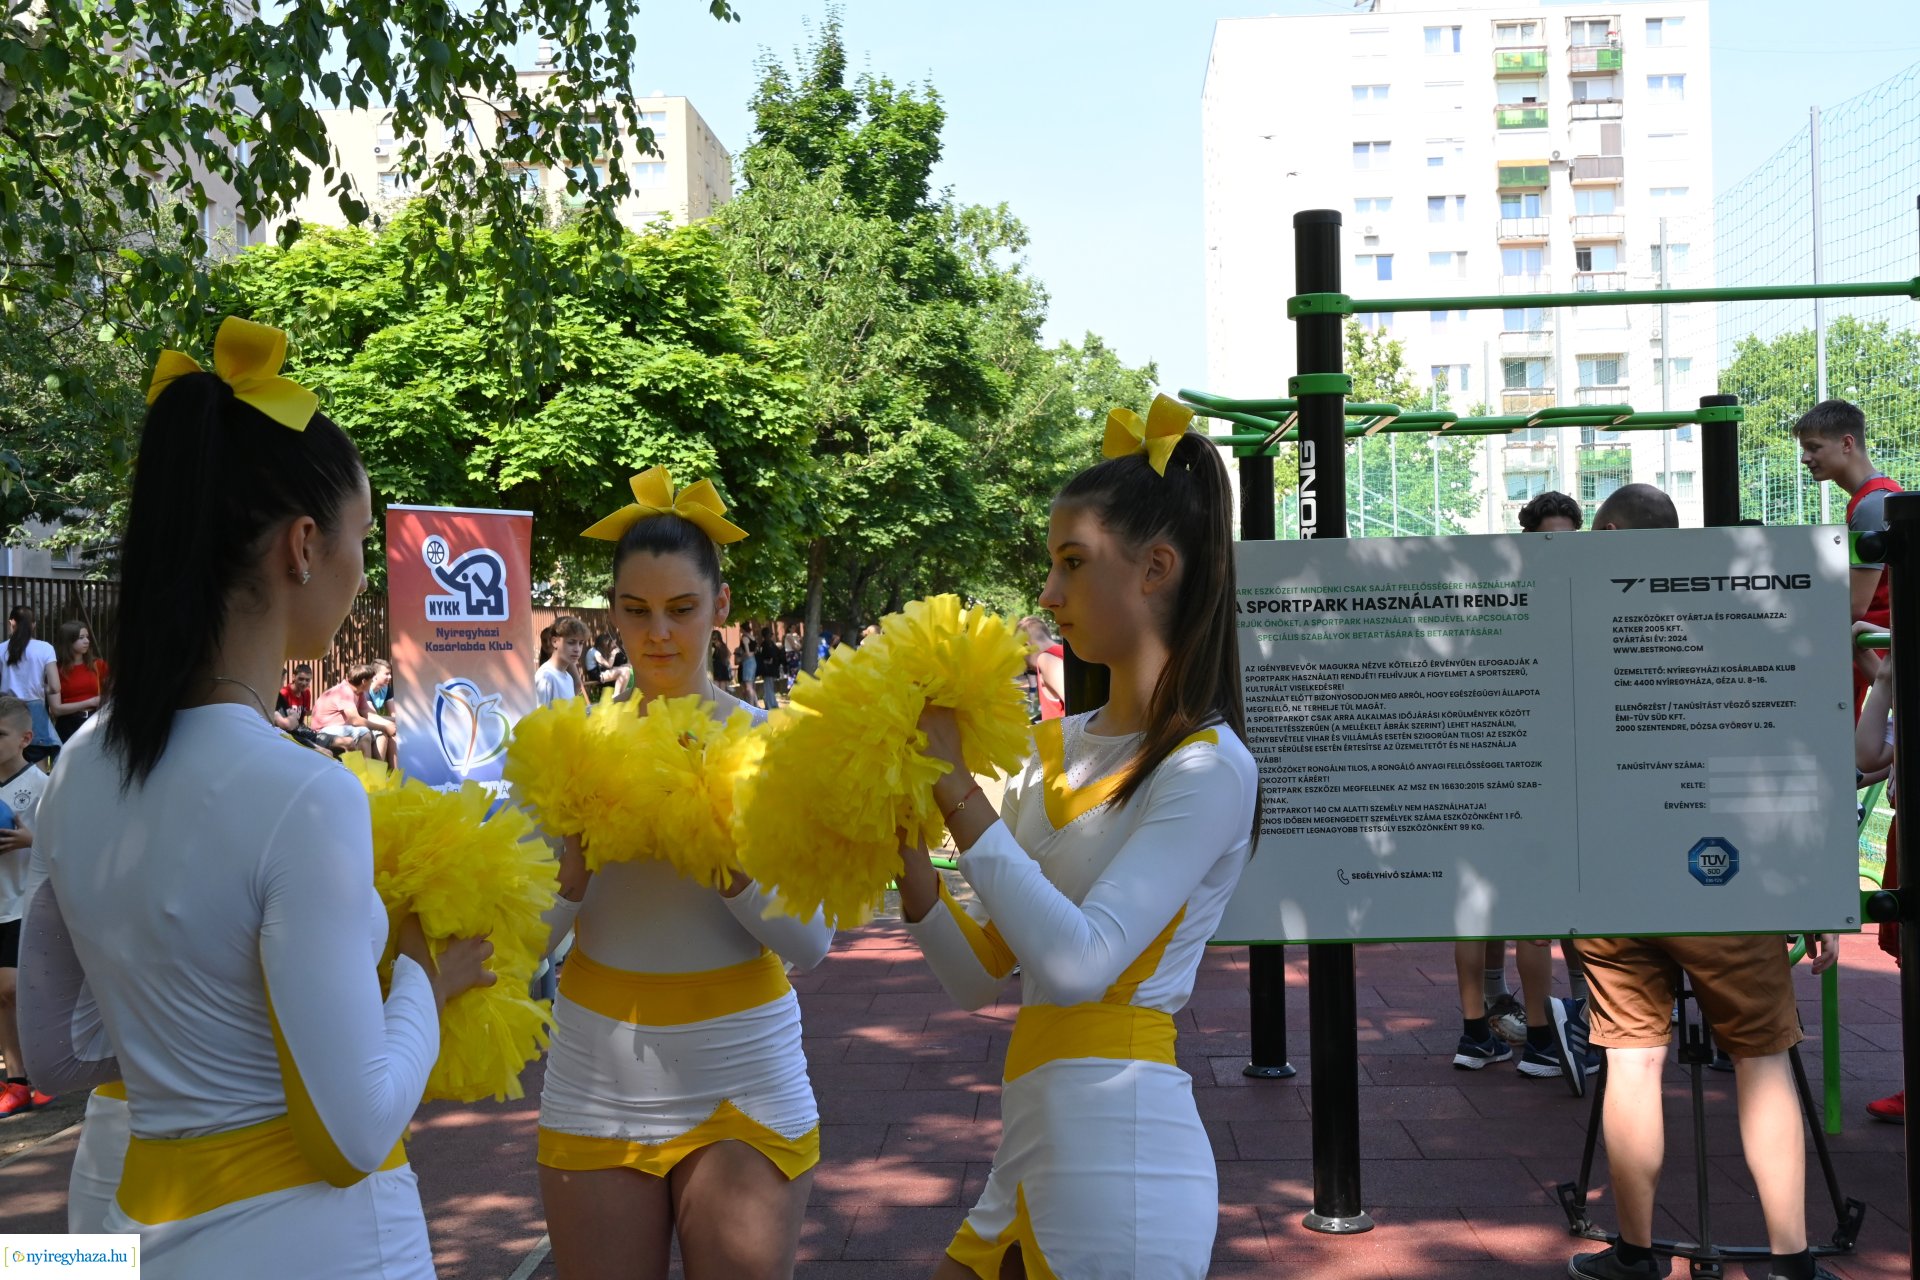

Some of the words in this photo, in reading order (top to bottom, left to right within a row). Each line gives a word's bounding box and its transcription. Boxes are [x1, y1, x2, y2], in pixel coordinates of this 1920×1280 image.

[1650, 573, 1811, 594] BESTRONG
[429, 601, 460, 615] NYKK
[1246, 598, 1347, 614] SPORTPARK
[1352, 591, 1458, 611] HASZNÁLATI
[1463, 593, 1528, 608] RENDJE
[1612, 615, 1622, 623] AZ
[1624, 612, 1674, 623] ESZKÖZÖKET
[1676, 611, 1713, 622] GYÁRTJA
[1715, 611, 1724, 621] ÉS
[1725, 612, 1787, 620] FORGALMAZZA:
[1612, 625, 1643, 633] KATKER
[1644, 624, 1664, 633] 2005
[1666, 624, 1684, 632] KFT.
[1612, 633, 1652, 644] GYÁRTÁSI
[1654, 632, 1666, 643] ÉV:
[1667, 634, 1687, 642] 2024
[489, 641, 512, 651] Klub
[1613, 644, 1704, 654] WWW.BESTRONG.COM
[1319, 662, 1359, 670] MAGUKRA
[1362, 659, 1386, 669] NÉZVE
[1478, 656, 1529, 666] ELFOGADJÁK
[1666, 663, 1719, 674] NYÍREGYHÁZI
[1720, 662, 1774, 673] KOSÁRLABDA
[1775, 664, 1796, 672] KLUB
[1245, 674, 1290, 682] SPORTPARK
[1292, 671, 1338, 681] HASZNÁLATI
[1340, 670, 1376, 680] RENDJÉT!
[1378, 669, 1418, 679] FELHÍVJUK
[1427, 670, 1467, 678] FIGYELMET
[1633, 678, 1654, 686] 4400
[1715, 674, 1736, 685] GÉZA
[1737, 676, 1745, 684] U.
[1747, 676, 1768, 684] 8-16.
[1245, 683, 1287, 693] KULTURÁLT
[1289, 682, 1345, 692] VISELKEDÉSRE!
[1246, 692, 1289, 703] HASZNÁLAT
[1314, 692, 1378, 701] BIZONYOSODJON
[1380, 692, 1397, 700] MEG
[1449, 688, 1500, 698] EGÉSZÉGÜGYI
[1502, 686, 1541, 697] ÁLLAPOTA
[1304, 704, 1338, 712] TERHELJE
[1340, 701, 1353, 711] TÚL
[1355, 700, 1387, 710] MAGÁT.
[1672, 699, 1722, 710] TANÚSÍTÁST
[1751, 700, 1797, 708] SZERVEZET:
[1253, 714, 1308, 723] SPORTPARKOT
[1333, 713, 1354, 721] ARRA
[1356, 712, 1396, 720] ALKALMAS
[1441, 708, 1497, 719] KÖRÜLMÉNYEK
[1499, 708, 1531, 717] KÖZÖTT
[1615, 711, 1649, 722] ÉMI-TÜV
[1650, 711, 1667, 721] SÜD
[1668, 713, 1686, 721] KFT.
[1342, 721, 1381, 731] MELLÉKELT
[1383, 720, 1409, 730] ÁBRÁK
[1411, 721, 1445, 731] SZERINT)
[1447, 721, 1469, 729] LEHET
[1470, 718, 1516, 729] HASZNÁLNI,
[1615, 724, 1635, 732] 2000
[1637, 723, 1688, 733] SZENTENDRE,
[1690, 720, 1717, 730] DÓZSA
[1718, 719, 1752, 730] GYÖRGY
[1754, 721, 1762, 729] U.
[1763, 721, 1776, 729] 26.
[1341, 731, 1382, 742] VILLÁMLÁS
[1384, 731, 1411, 740] ESETÉN
[1413, 730, 1458, 740] SZIGORÚAN
[1460, 731, 1484, 739] TILOS!
[1498, 728, 1528, 738] ESZKÖZ
[1277, 743, 1312, 753] SÉRÜLÉSE
[1314, 742, 1342, 752] ESETÉN
[1344, 742, 1381, 752] ÉRTESÍTSE
[1471, 738, 1517, 749] HASZNÁLJA
[1259, 764, 1306, 774] ESZKÖZÖKET
[1307, 763, 1346, 773] RONGÁLNI
[1347, 764, 1369, 773] TILOS,
[1378, 761, 1415, 771] RONGÁLÓ
[1505, 760, 1543, 768] TARTOZIK
[1616, 760, 1672, 771] TANÚSÍTVÁNY
[1674, 759, 1705, 770] SZÁMA:
[1298, 773, 1330, 783] KÁRÉRT!
[1304, 783, 1340, 793] ESZKÖZEI
[1342, 784, 1394, 792] MEGFELELNEK
[1410, 783, 1426, 791] MSZ
[1441, 782, 1484, 790] 16630:2015
[1486, 780, 1514, 789] SZÁMÚ
[1516, 781, 1543, 789] SZAB-
[1680, 781, 1706, 789] KELTE:
[1313, 806, 1326, 814] 140
[1342, 805, 1368, 813] ALATTI
[1370, 802, 1402, 812] SZEMÉLY
[1404, 804, 1421, 812] NEM
[1423, 800, 1487, 811] HASZNÁLHATJA!
[1664, 799, 1707, 810] ÉRVÉNYES:
[1313, 815, 1368, 824] MEGENGEDETT
[1370, 812, 1412, 822] SZEMÉLYEK
[1414, 812, 1441, 822] SZÁMA
[1443, 810, 1503, 821] ESZKÖZÖNKÉNT
[1306, 826, 1357, 834] LEGNAGYOBB
[1360, 823, 1395, 833] TESTSÚLY
[1397, 822, 1457, 832] ESZKÖZÖNKÉNT
[1701, 854, 1726, 866] TÜV
[1351, 869, 1398, 880] SEGÉLYHÍVÓ
[1400, 868, 1430, 879] SZÁMA:
[1432, 870, 1443, 878] 112
